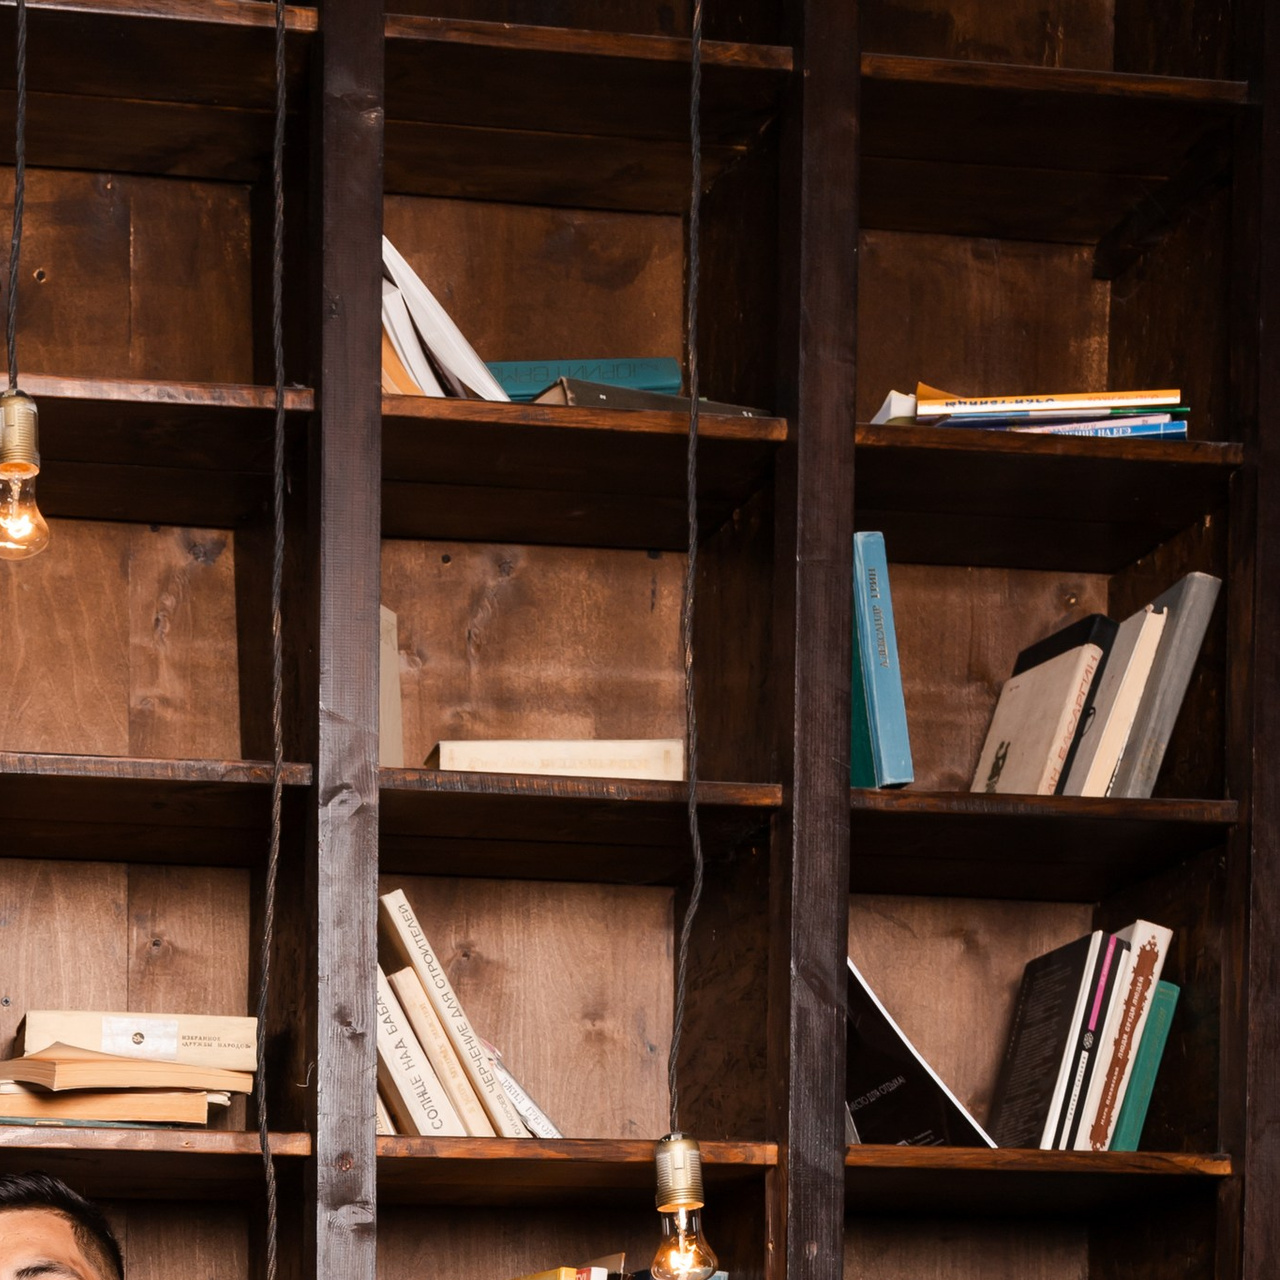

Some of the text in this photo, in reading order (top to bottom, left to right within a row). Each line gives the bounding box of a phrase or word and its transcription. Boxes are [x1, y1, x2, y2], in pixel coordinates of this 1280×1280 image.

[865, 566, 891, 668] АЛЕКСАНДР ГРИН
[1055, 653, 1100, 761] БАСАРГИН
[181, 1034, 220, 1042] ИЗБРАННОЕ
[395, 899, 499, 1094] ЧЕРЧЕНИЕ ДЛЯ СТРОИТЕЛЕЙ
[1115, 974, 1147, 1060] ЛЮДИ СРЕДИ ЛЮДЕЙ
[391, 1036, 445, 1130] СОЛНЦЕ НАД
